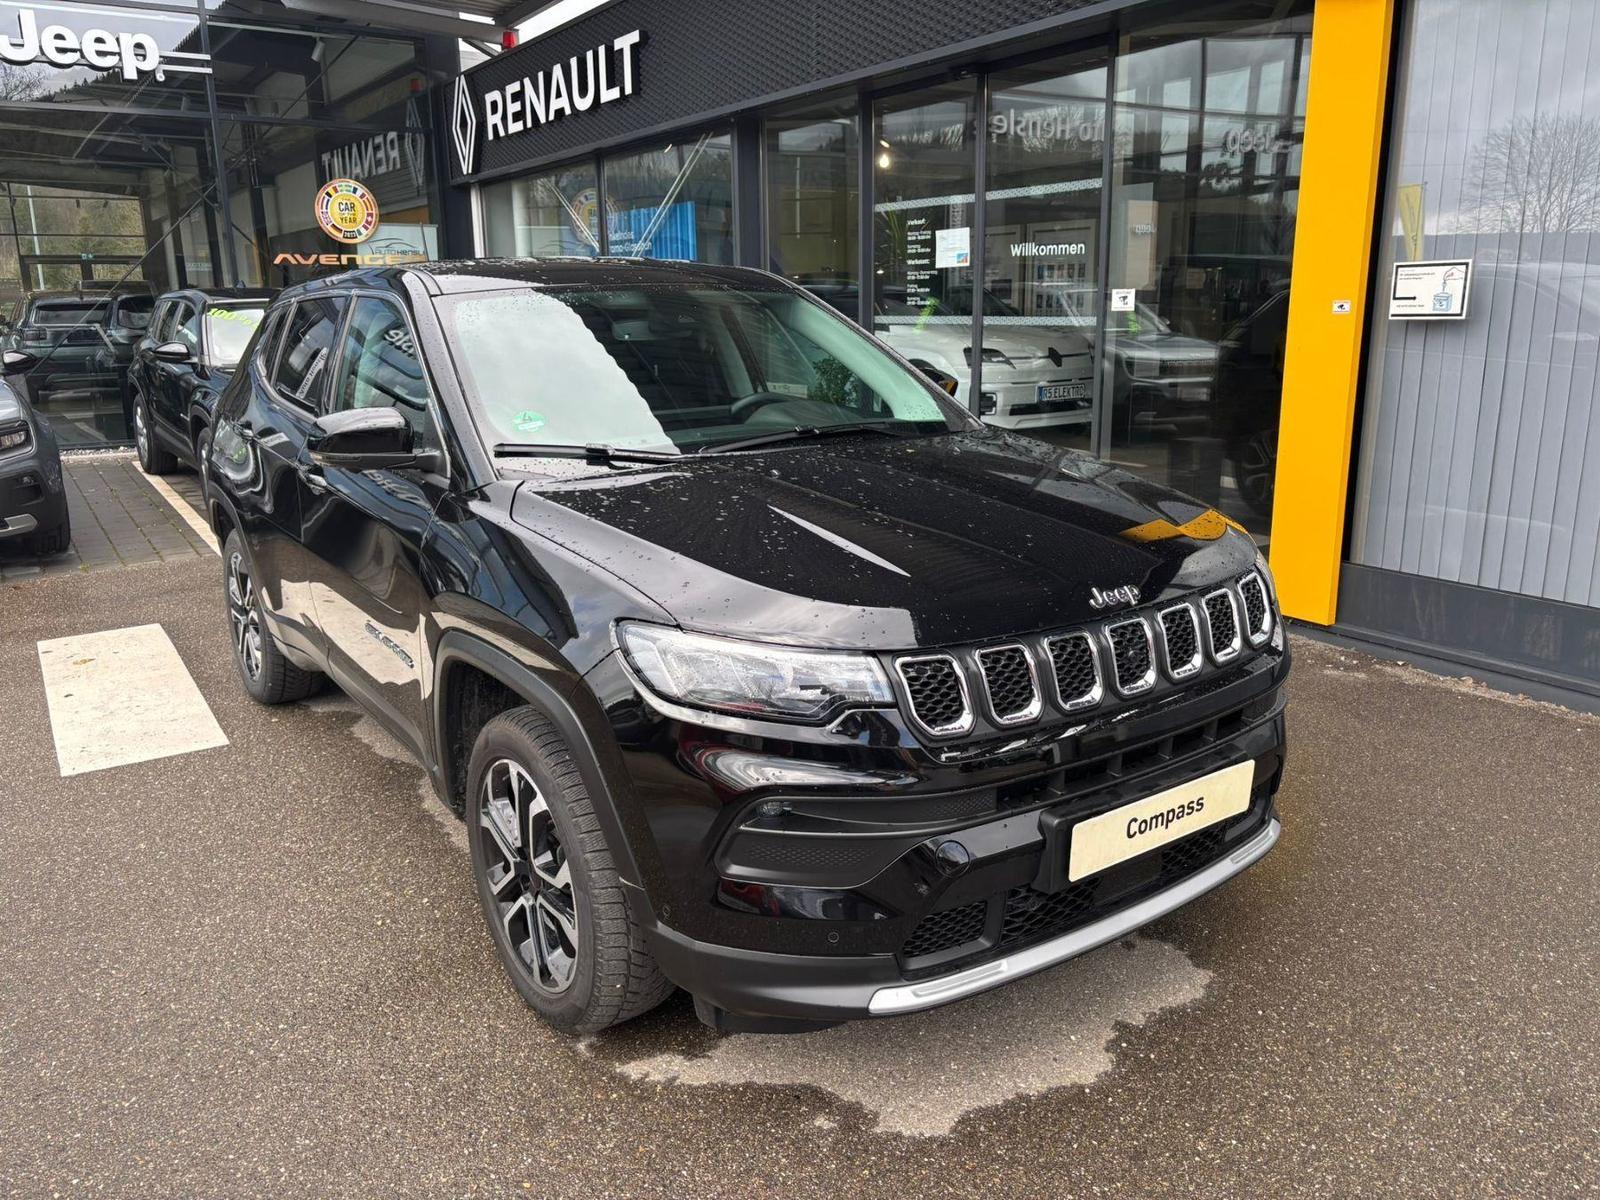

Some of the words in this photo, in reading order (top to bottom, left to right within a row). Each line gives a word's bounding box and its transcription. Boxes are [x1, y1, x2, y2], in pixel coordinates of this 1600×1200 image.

[0, 8, 160, 80] Jeep
[484, 29, 640, 141] RENAULT
[338, 202, 356, 212] CAR
[1010, 242, 1086, 257] Willkommen
[1088, 584, 1141, 609] Jeep
[1126, 796, 1205, 839] Compass
